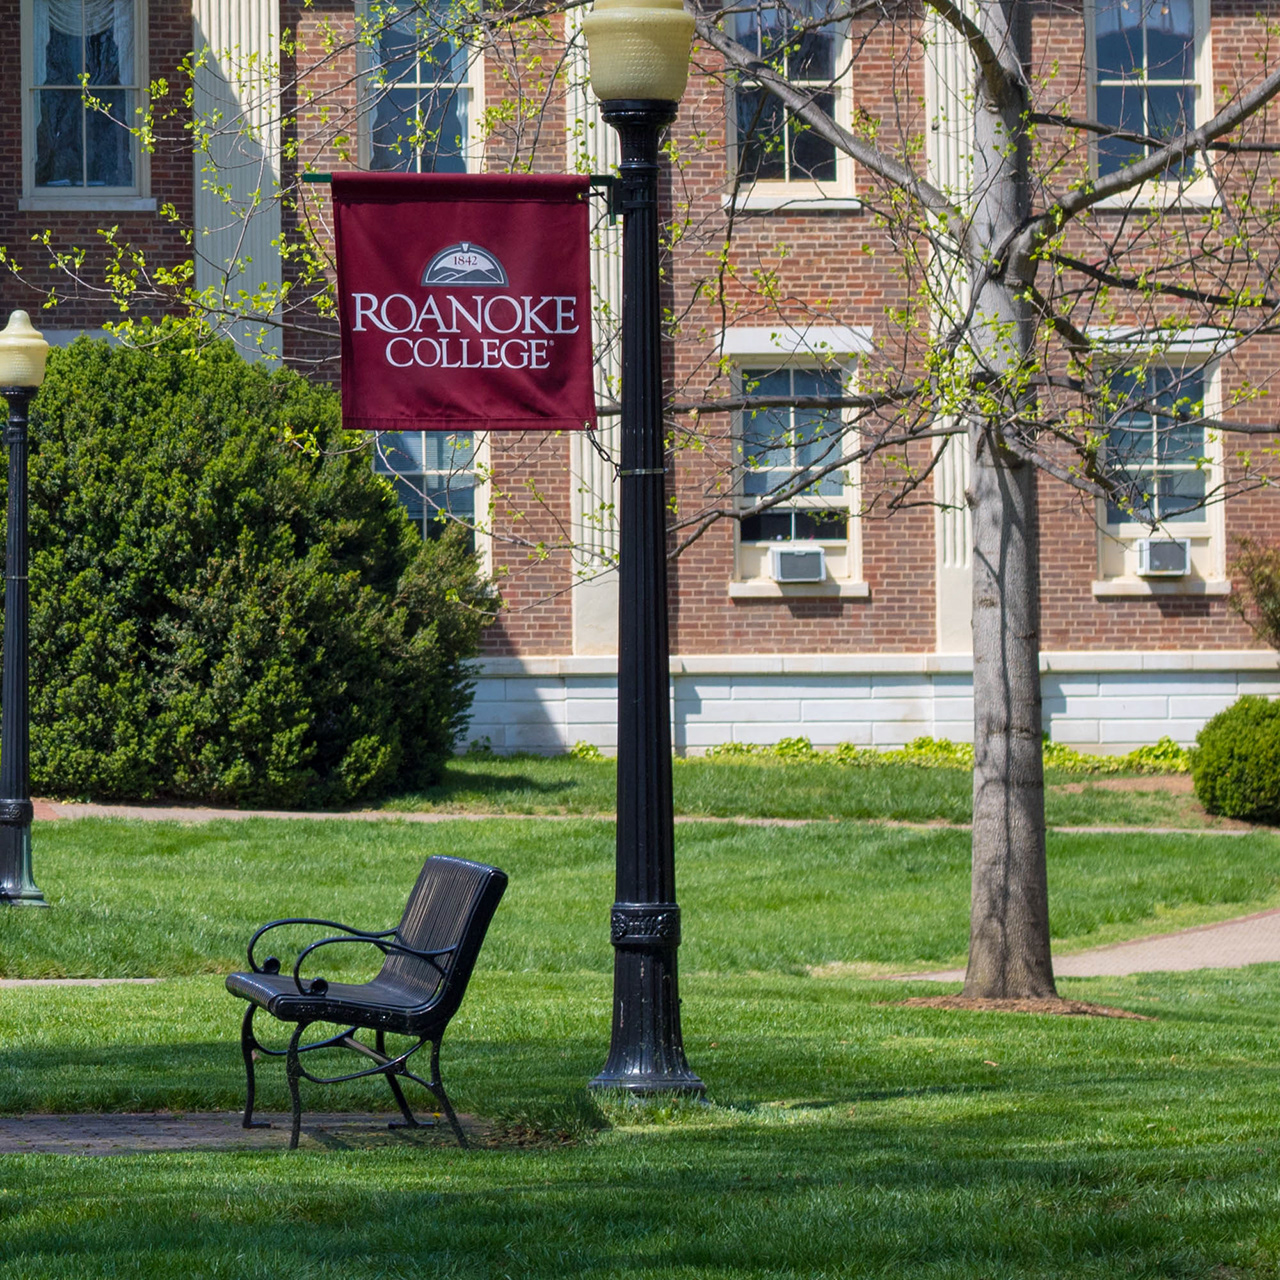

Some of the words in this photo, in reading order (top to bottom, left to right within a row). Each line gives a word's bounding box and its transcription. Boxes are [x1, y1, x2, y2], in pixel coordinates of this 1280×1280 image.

[453, 256, 478, 266] 1842
[351, 293, 580, 335] ROANOKE
[385, 337, 551, 369] COLLEGE
